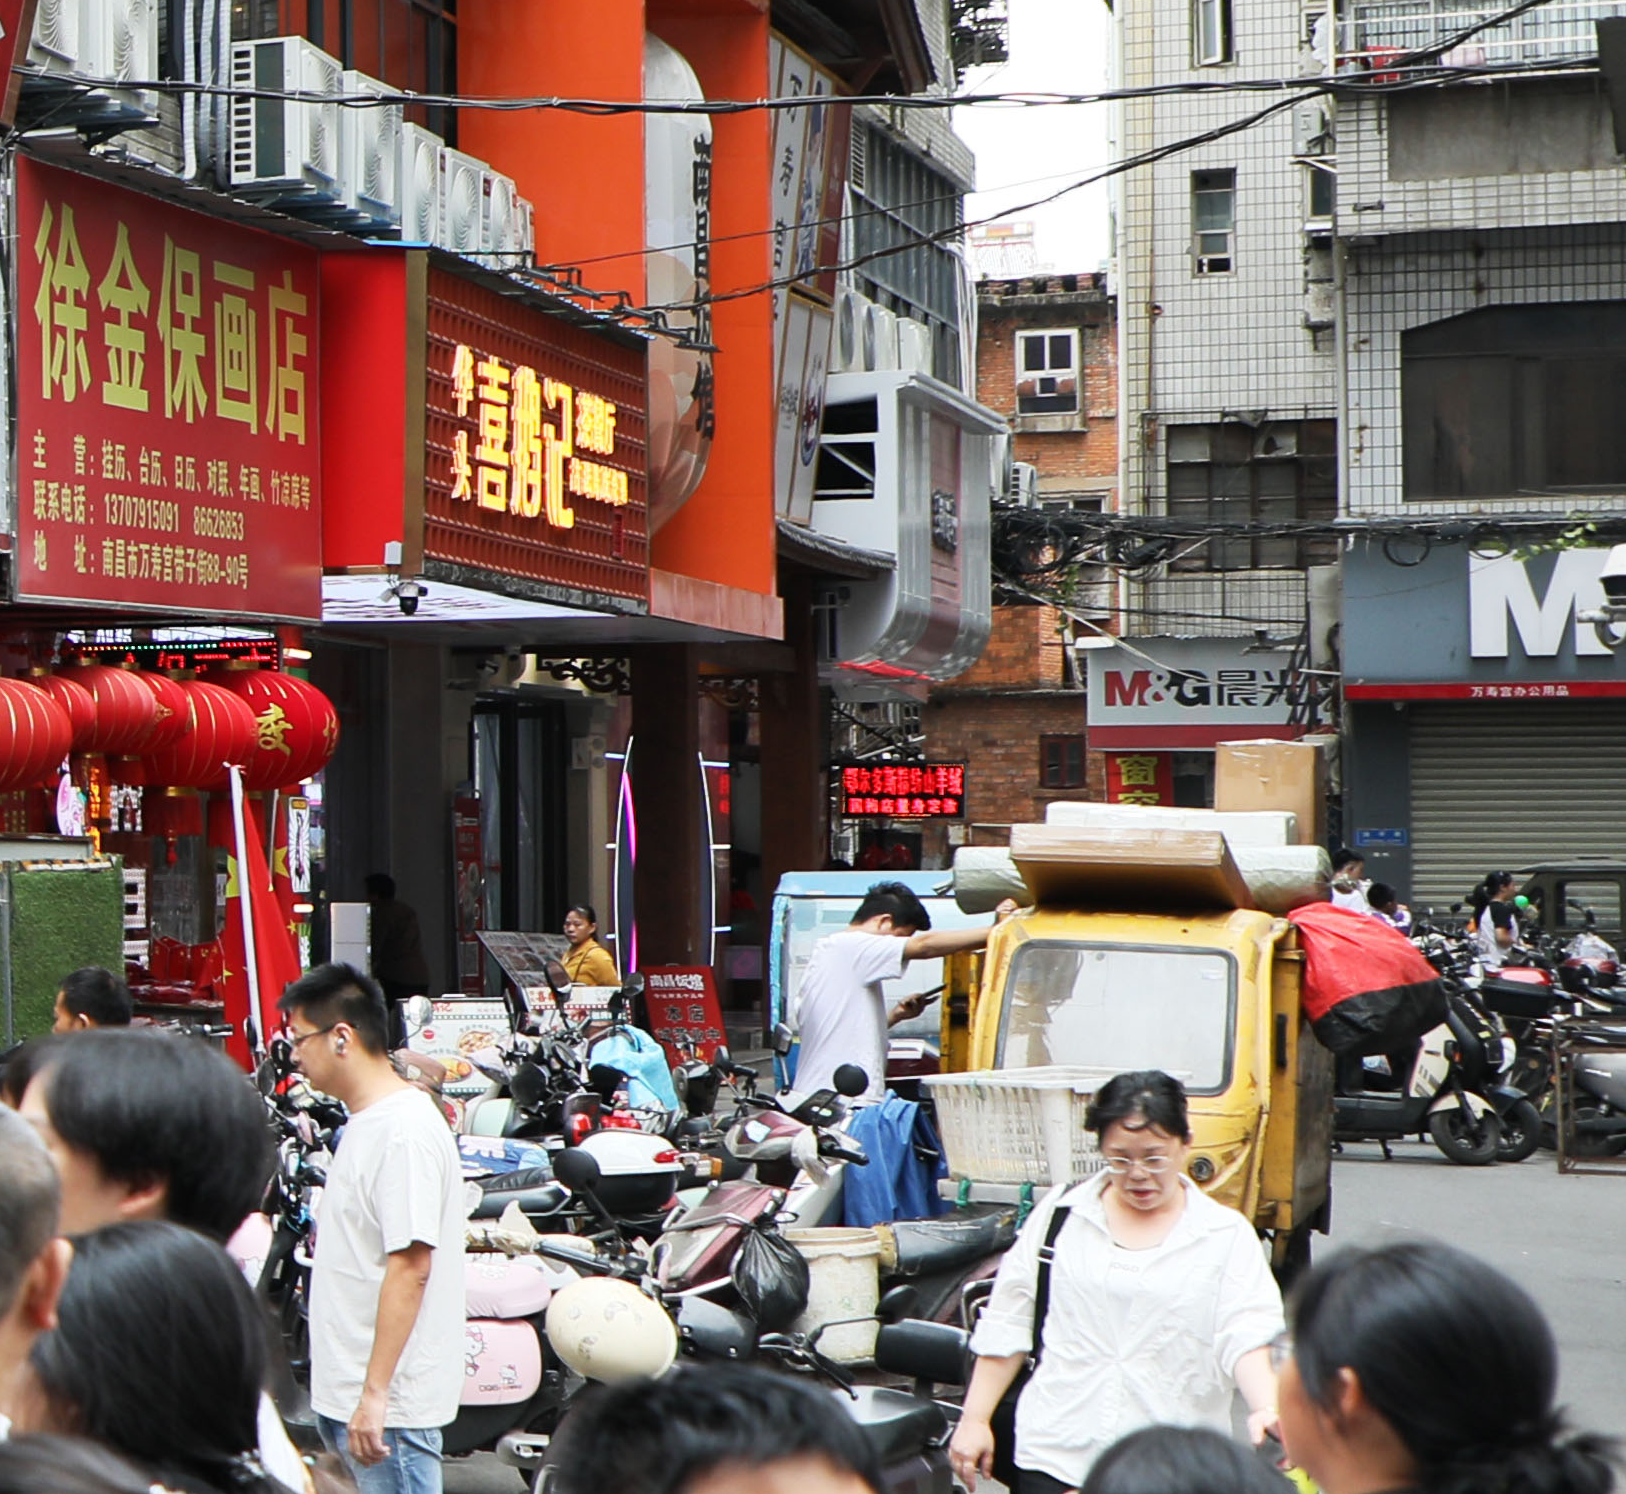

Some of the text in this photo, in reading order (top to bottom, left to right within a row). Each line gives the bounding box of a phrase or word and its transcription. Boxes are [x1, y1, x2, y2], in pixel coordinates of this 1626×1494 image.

[33, 200, 308, 446] 徐金保画店
[193, 505, 245, 542] 86626853
[1470, 685, 1570, 698] 万寿宫办公用品
